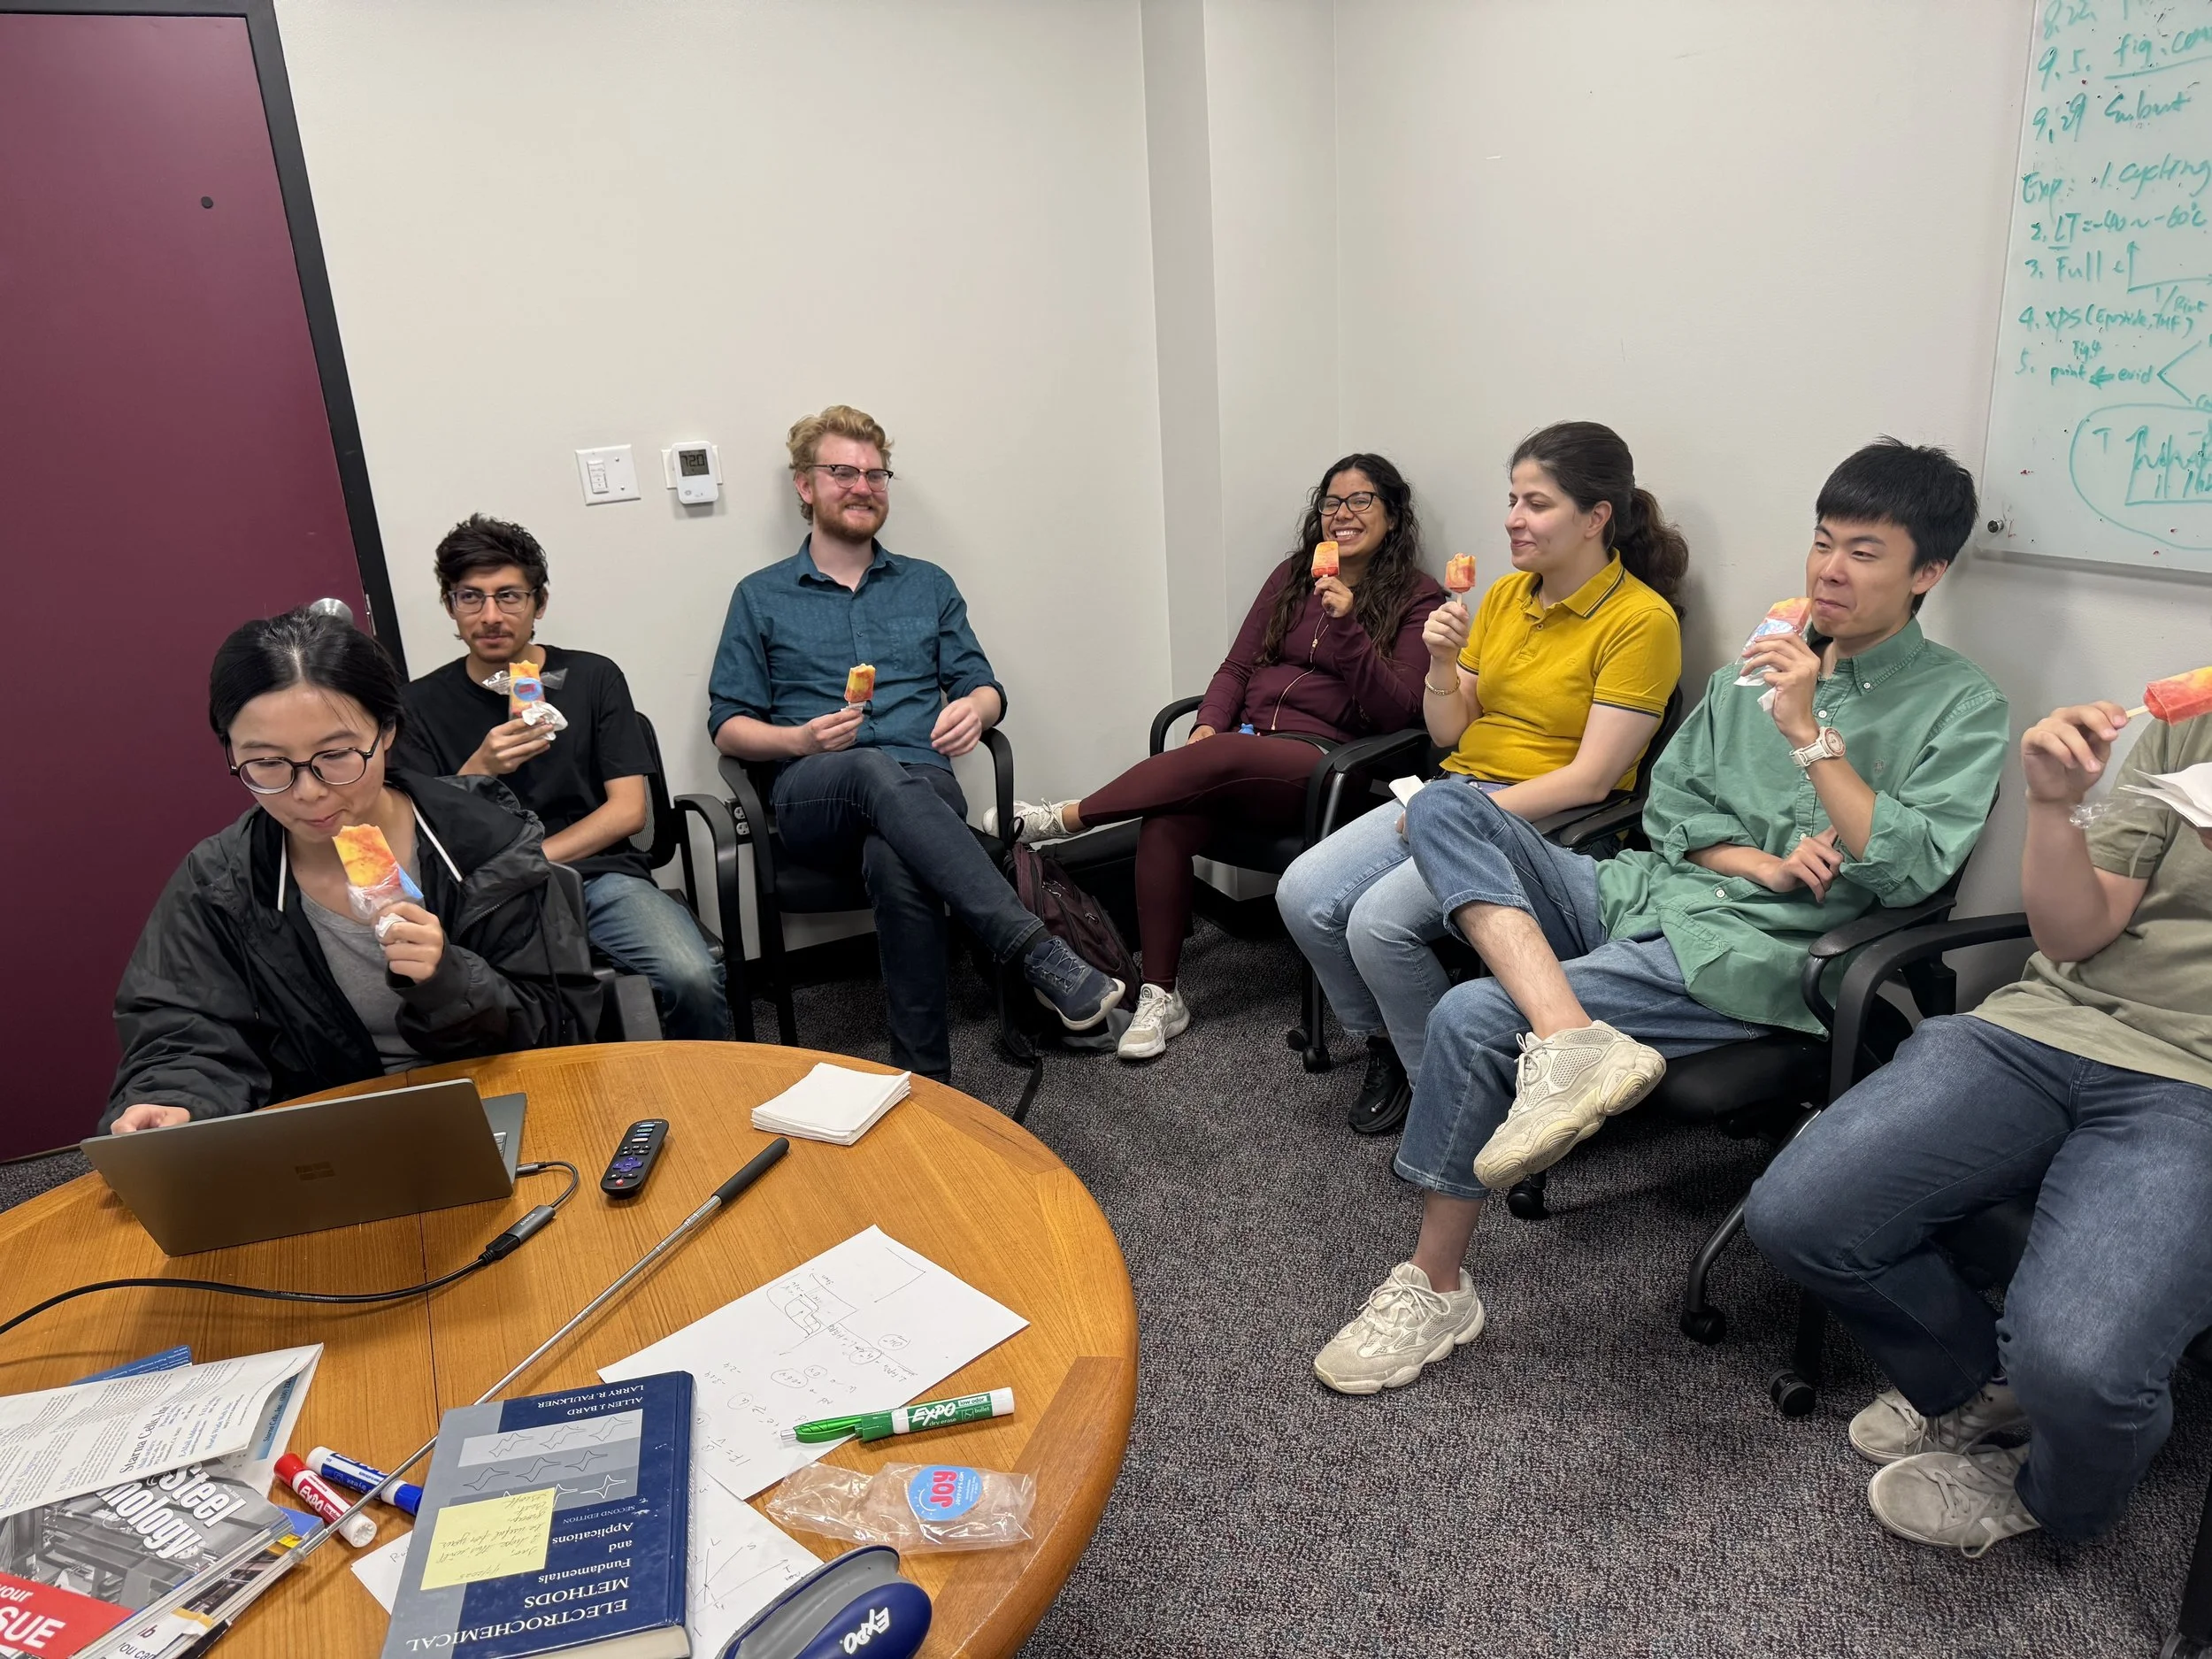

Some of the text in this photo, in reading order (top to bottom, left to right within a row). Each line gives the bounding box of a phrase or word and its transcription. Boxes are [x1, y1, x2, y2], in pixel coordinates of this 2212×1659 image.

[538, 1394, 595, 1409] FAULKNER
[609, 1385, 644, 1394] LARRY
[567, 1406, 597, 1416] BARD
[607, 1396, 643, 1409] ALLEN
[912, 1402, 956, 1426] EXPO
[159, 1462, 247, 1528] Steel
[930, 1470, 958, 1509] JOY
[95, 1481, 203, 1559] nology
[563, 1505, 635, 1524] SECOND EDITION
[552, 1522, 634, 1545] Applications
[608, 1540, 633, 1553] and
[538, 1557, 631, 1584] Fundamentals
[524, 1577, 629, 1609] METHODS
[406, 1599, 628, 1652] ELECTROCHEMICAL
[843, 1607, 891, 1655] EXPO
